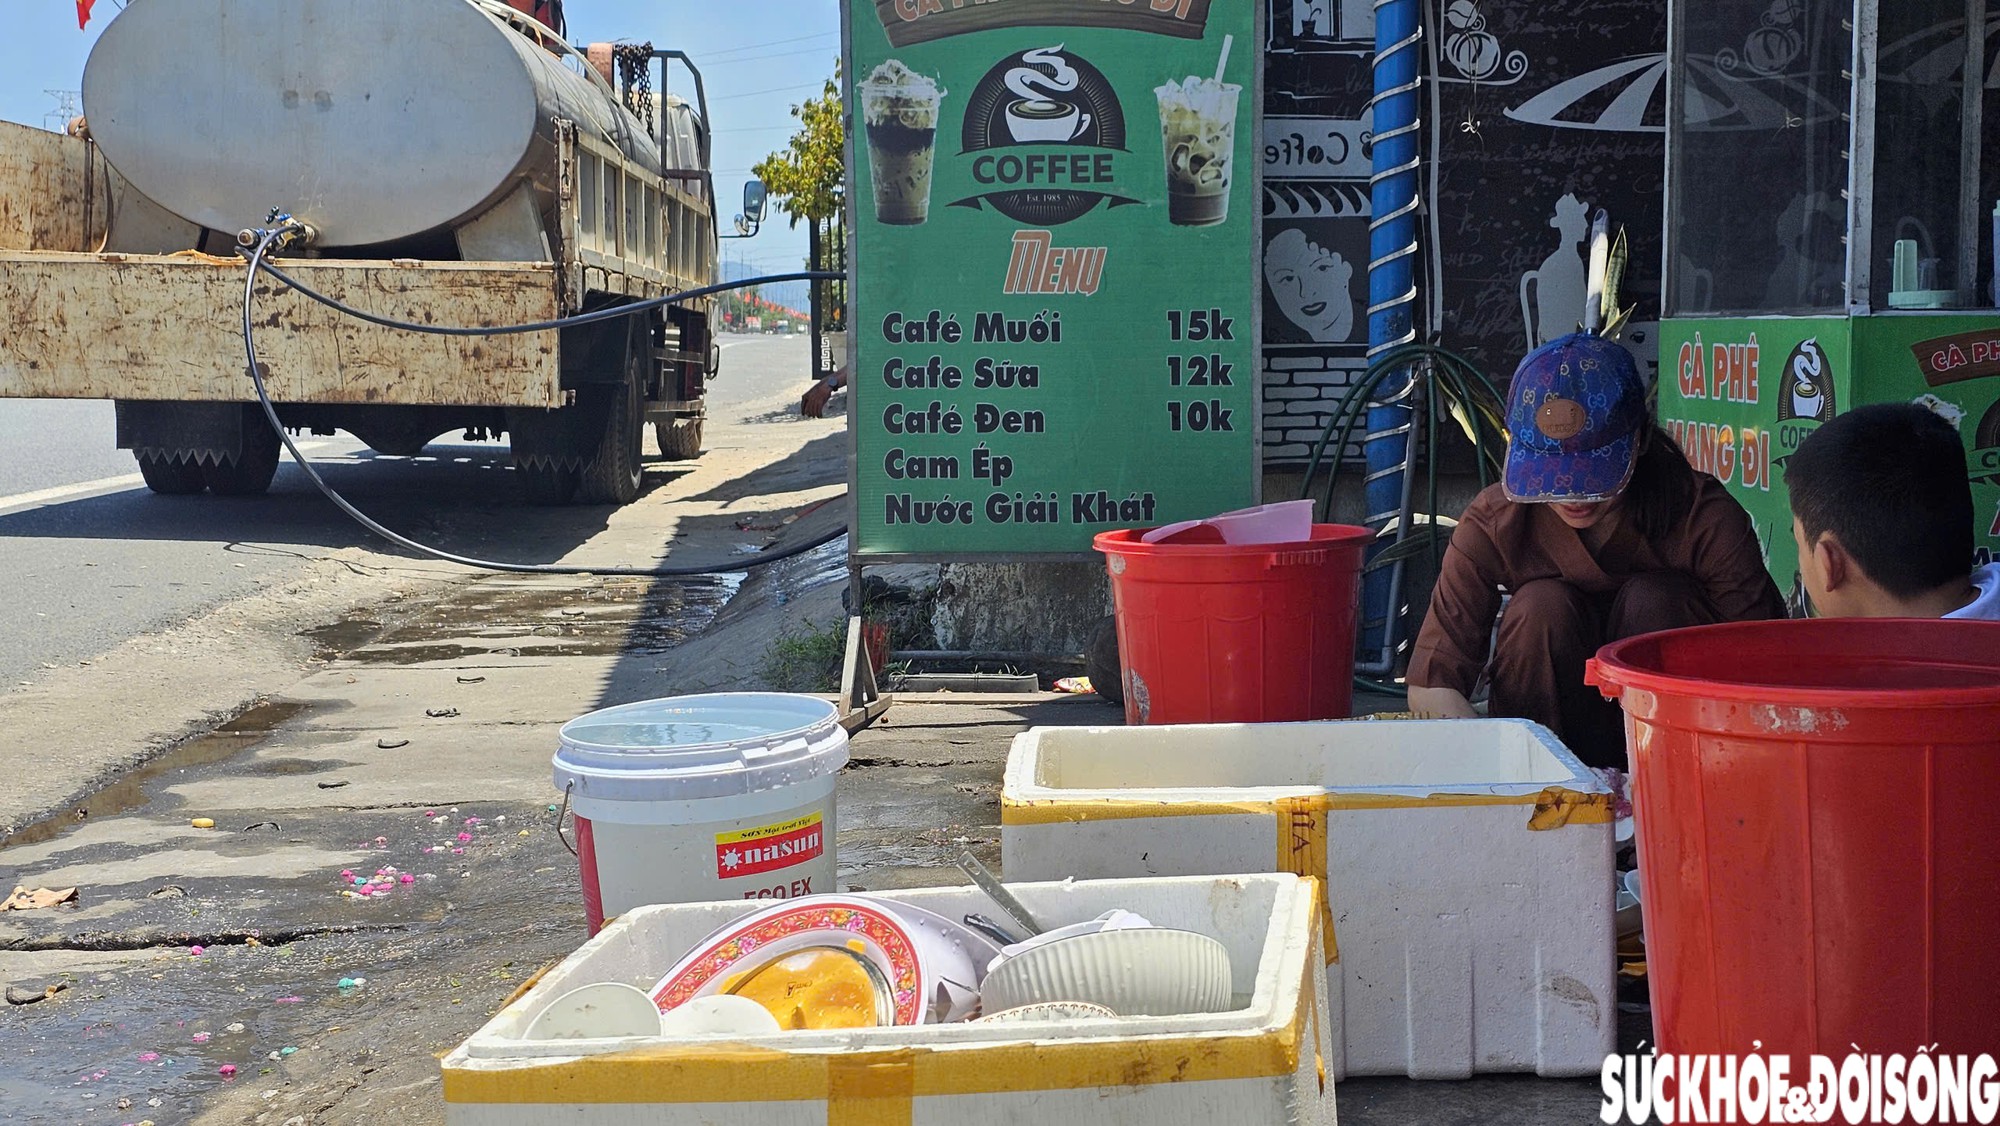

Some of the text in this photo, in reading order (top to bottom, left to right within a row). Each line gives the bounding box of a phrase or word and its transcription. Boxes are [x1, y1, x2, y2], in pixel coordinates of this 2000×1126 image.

[972, 154, 1114, 184] COFFEE
[1003, 230, 1107, 296] MENU
[882, 307, 1234, 345] Café Muối 15k
[883, 354, 1234, 389] Cafe Sữa 12k
[1678, 332, 1760, 404] CÀ PHÊ
[1931, 344, 1967, 371] CÀ
[883, 399, 1234, 435] Café Đen 10k
[884, 442, 1014, 486] Cam Ép
[1741, 428, 1769, 492] ĐI
[885, 490, 1156, 526] Nước Giải Khát
[745, 832, 819, 864] nasun
[791, 876, 812, 898] EX
